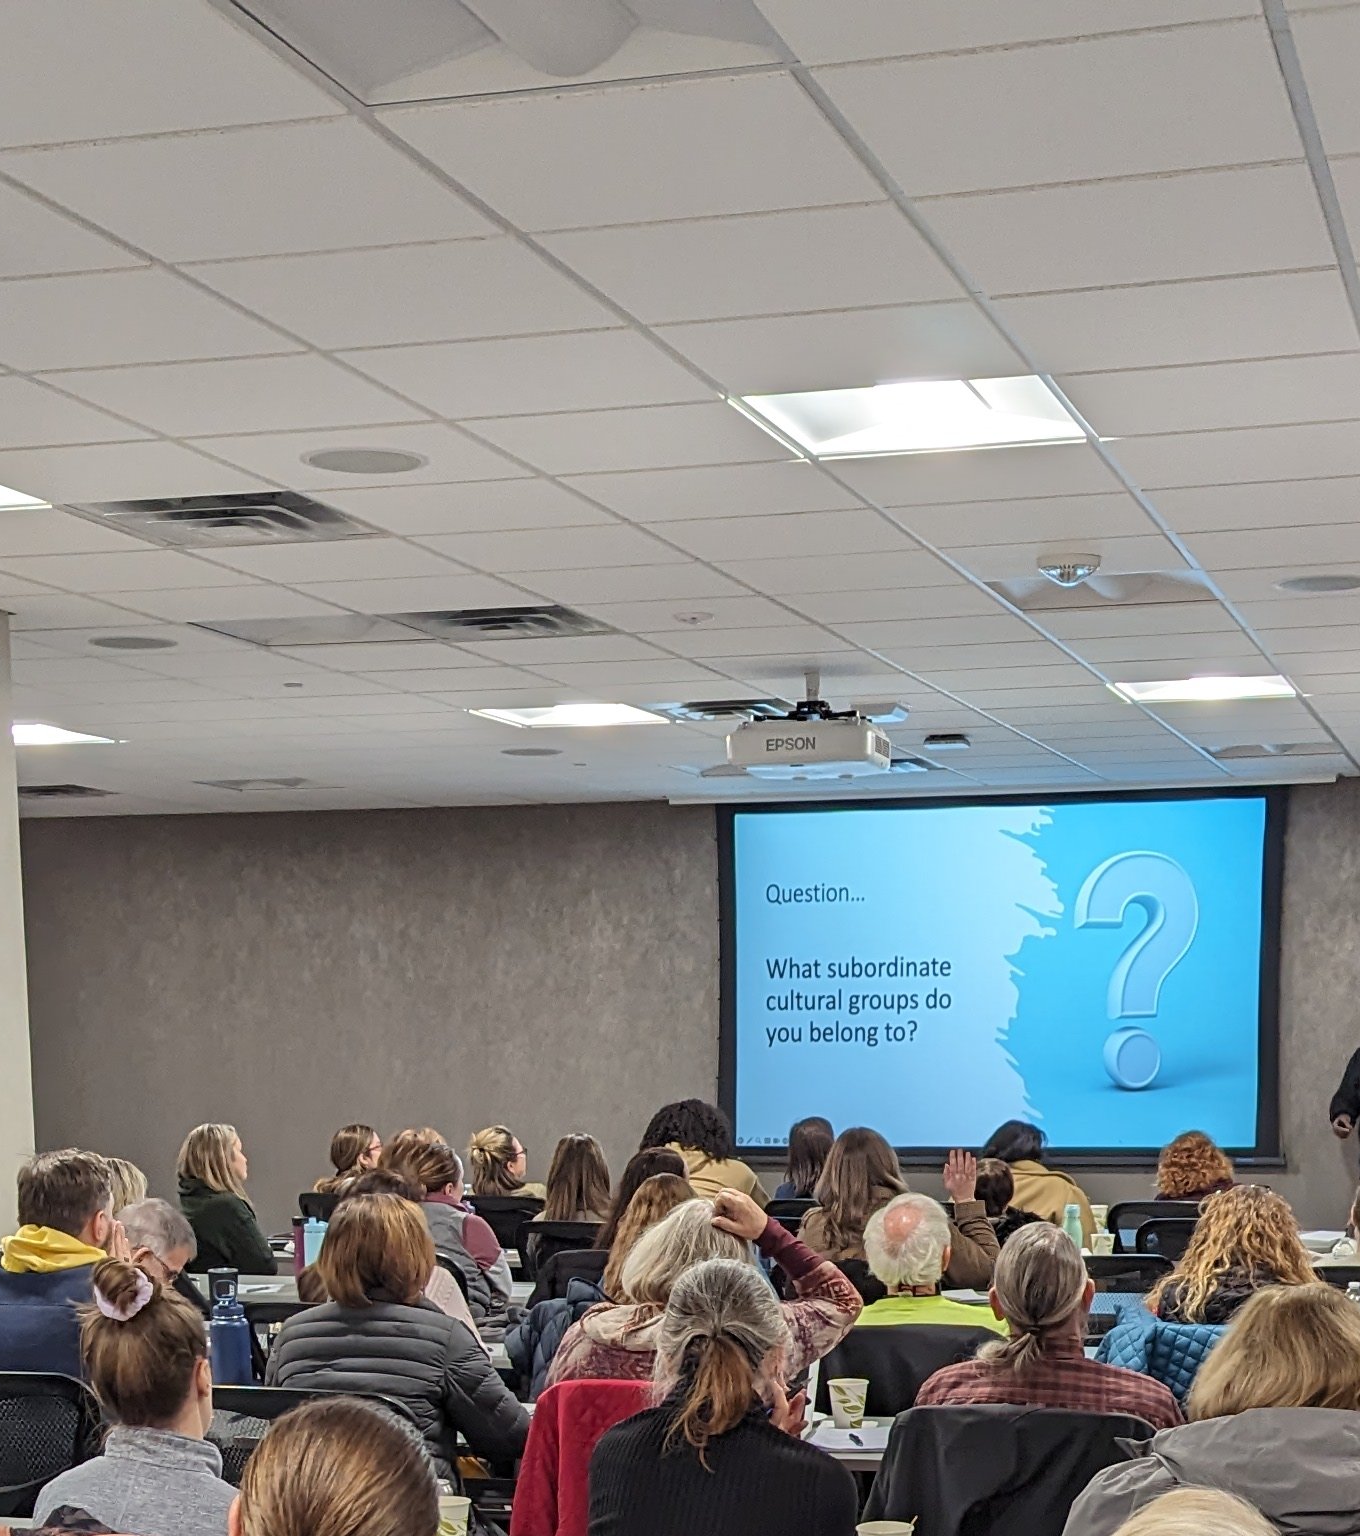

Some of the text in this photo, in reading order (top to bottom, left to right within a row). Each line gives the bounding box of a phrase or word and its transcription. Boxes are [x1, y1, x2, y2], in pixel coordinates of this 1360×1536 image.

[766, 737, 816, 752] EPSON
[765, 883, 865, 905] Question...
[766, 956, 952, 979] What subordinate
[766, 987, 952, 1015] cultural groups do
[766, 1019, 918, 1048] you belong to?
